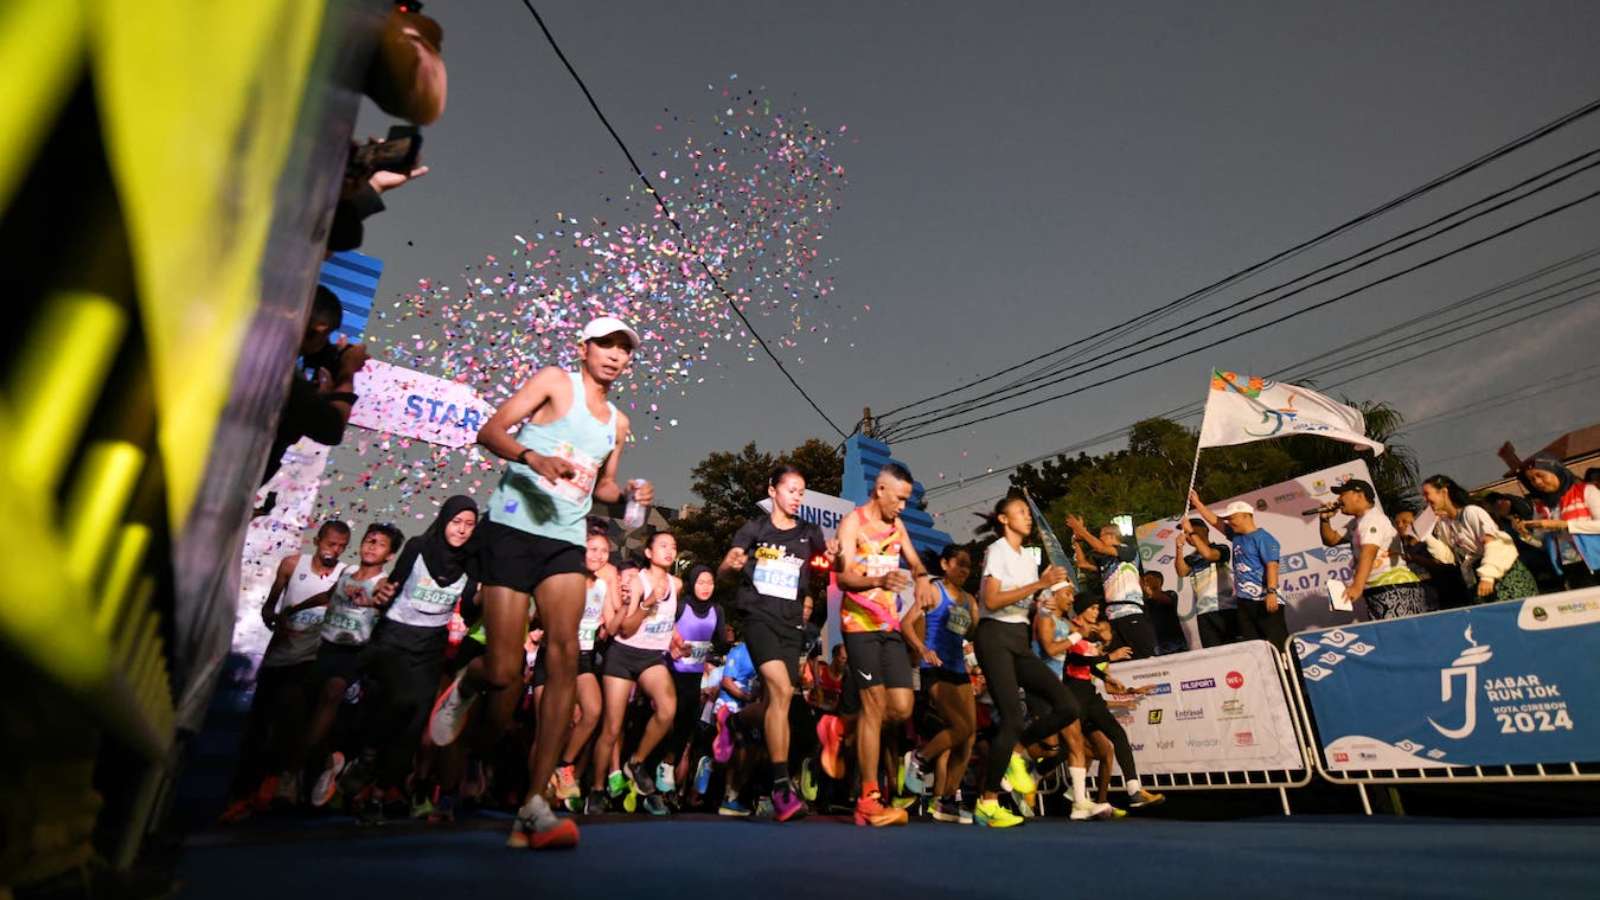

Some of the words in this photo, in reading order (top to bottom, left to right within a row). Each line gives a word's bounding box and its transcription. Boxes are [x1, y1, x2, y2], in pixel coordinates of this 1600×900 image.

[795, 503, 844, 529] INISH
[1484, 674, 1540, 690] JABAR
[1487, 688, 1524, 702] RUN
[1527, 685, 1560, 699] 10K
[1493, 705, 1519, 714] KOTA
[1520, 701, 1567, 713] CIREBON
[1496, 709, 1574, 734] 2024
